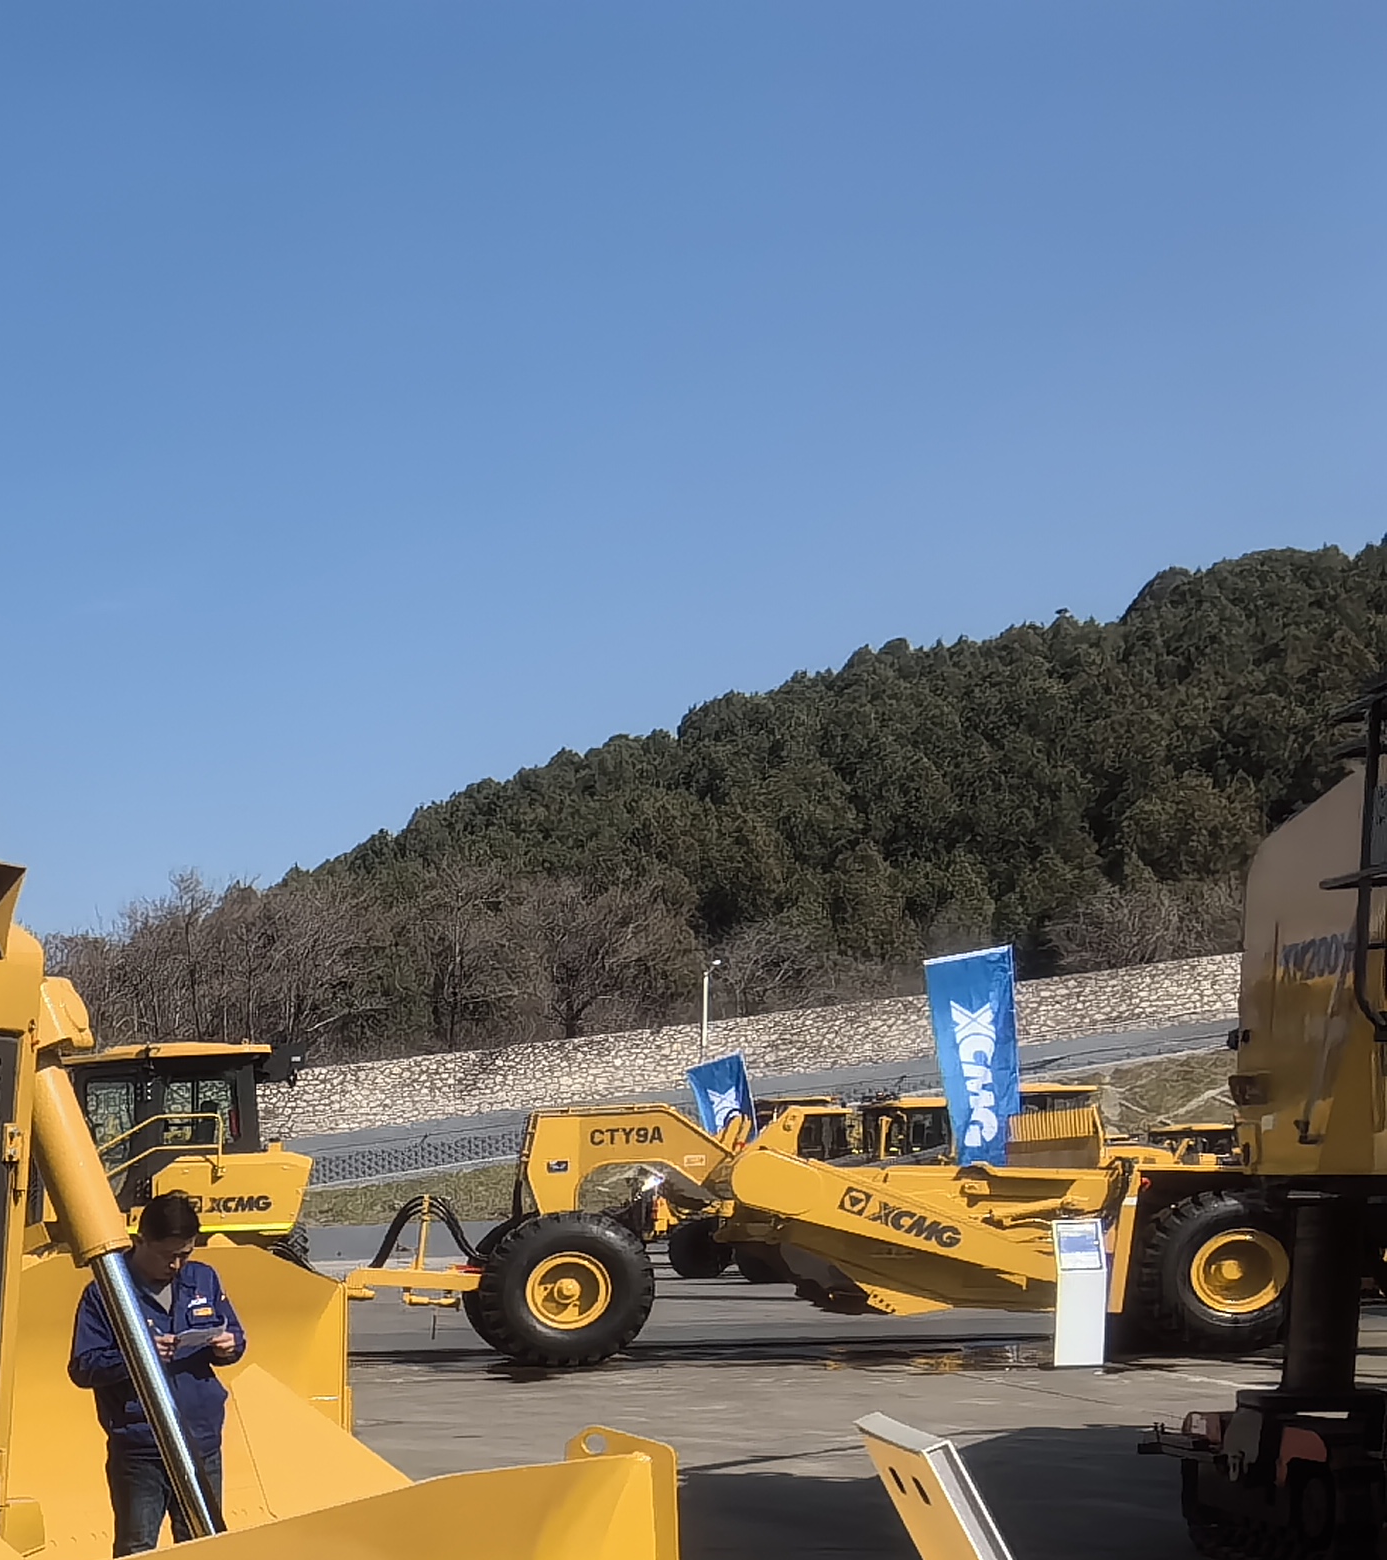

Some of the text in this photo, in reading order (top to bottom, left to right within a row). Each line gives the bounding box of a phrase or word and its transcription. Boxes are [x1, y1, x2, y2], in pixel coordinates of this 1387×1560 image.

[950, 1001, 998, 1147] XCMG
[589, 1125, 664, 1146] CTY9A
[204, 1195, 272, 1213] XCMG
[864, 1200, 962, 1248] XCMG
